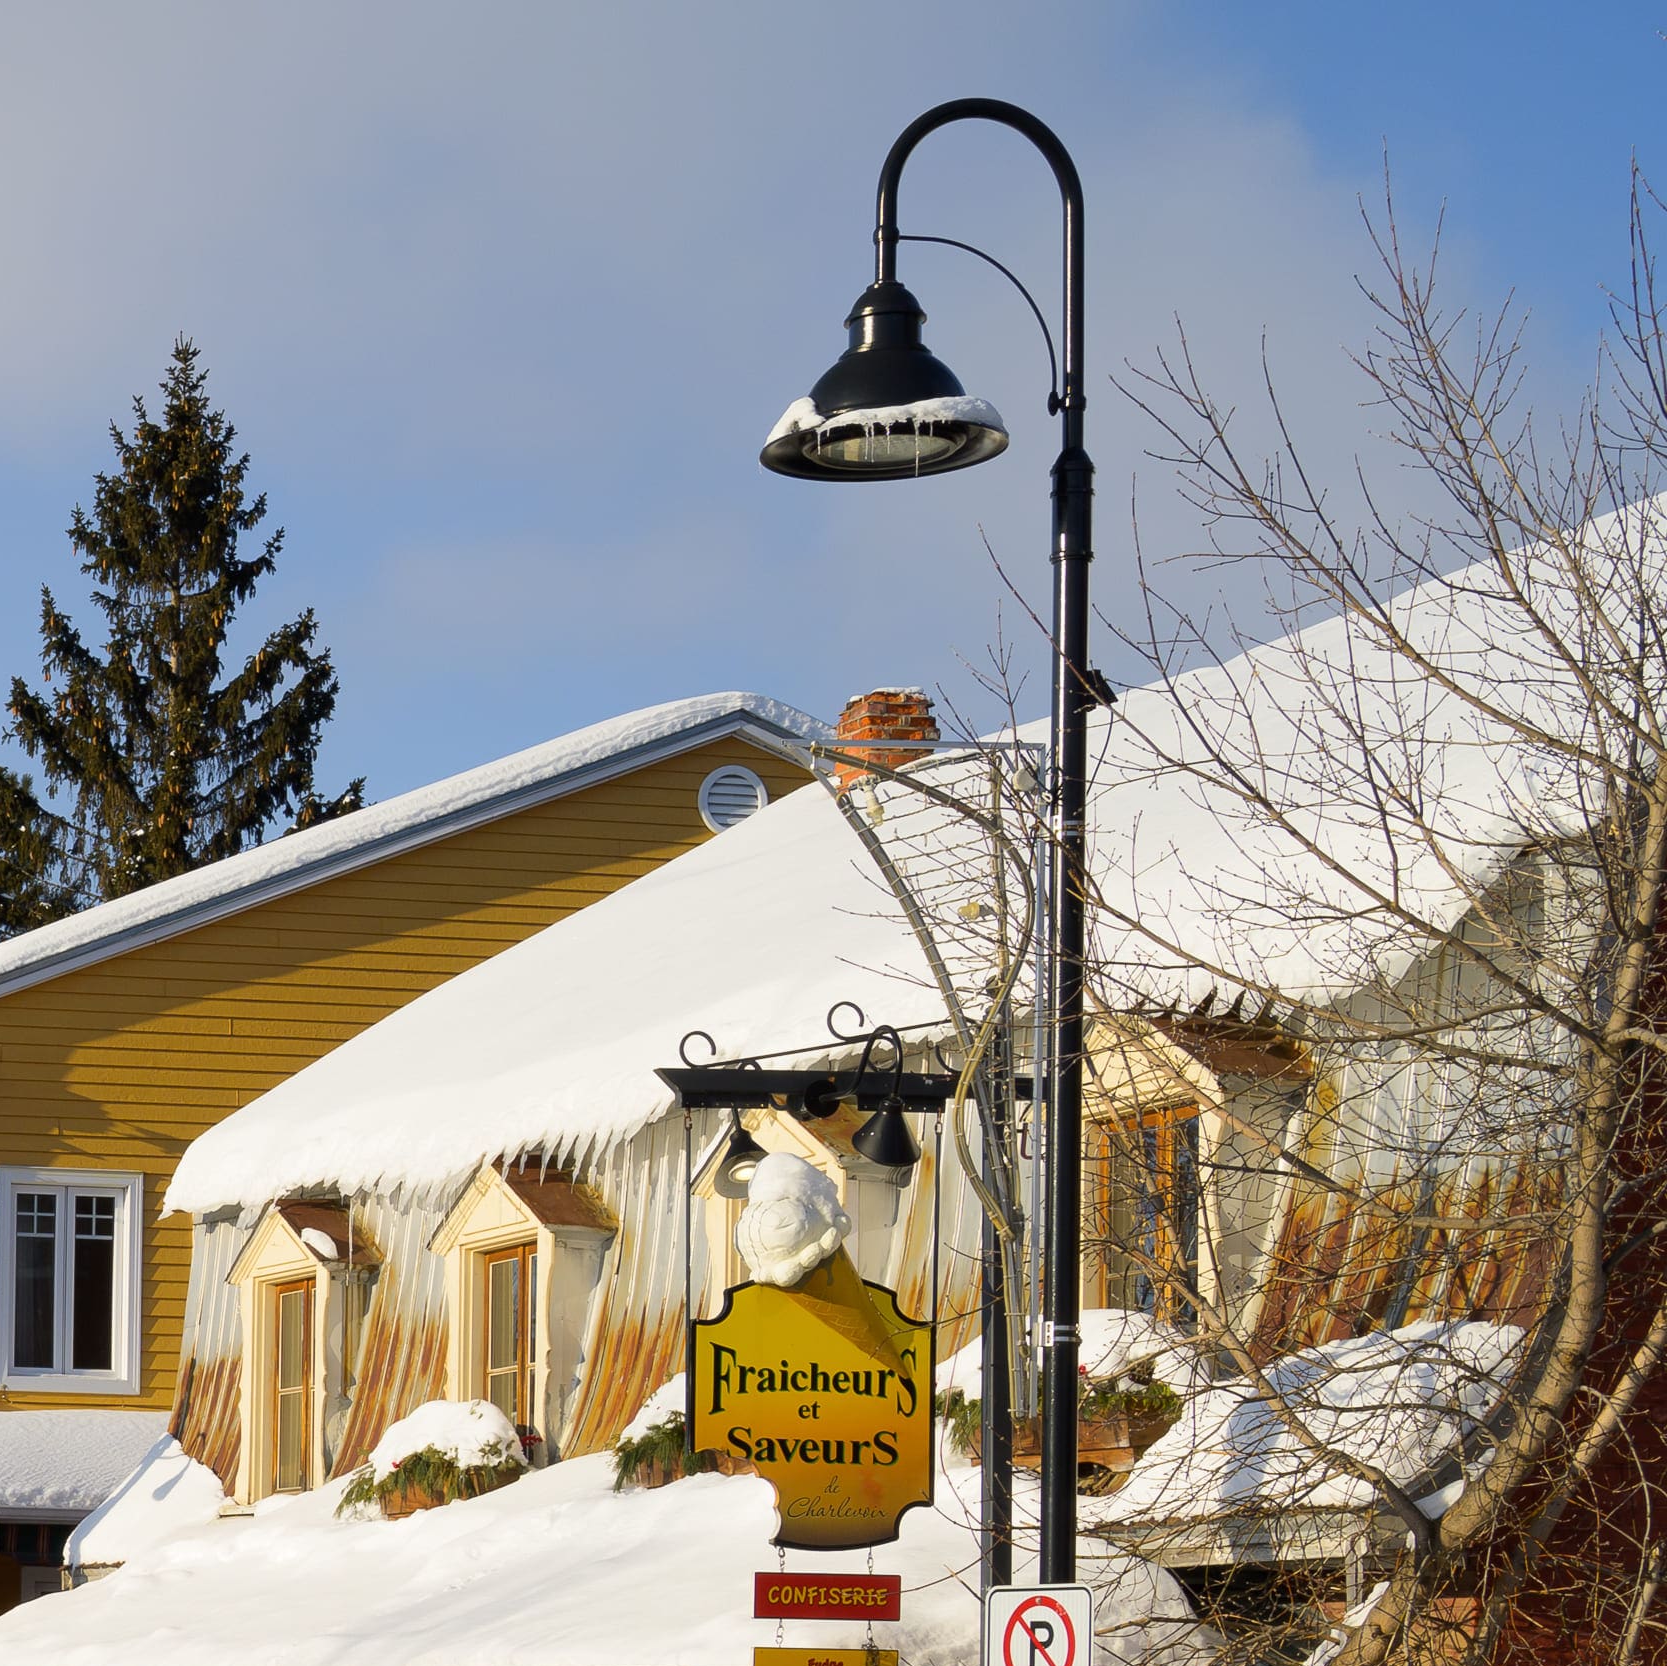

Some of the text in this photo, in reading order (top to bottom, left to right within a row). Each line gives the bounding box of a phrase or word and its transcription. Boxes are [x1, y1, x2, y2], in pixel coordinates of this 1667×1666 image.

[797, 1401, 821, 1419] et
[727, 1426, 899, 1466] SaveurS
[823, 1475, 840, 1494] de
[787, 1496, 889, 1519] Charlevoix
[768, 1585, 888, 1606] CONFISERIE
